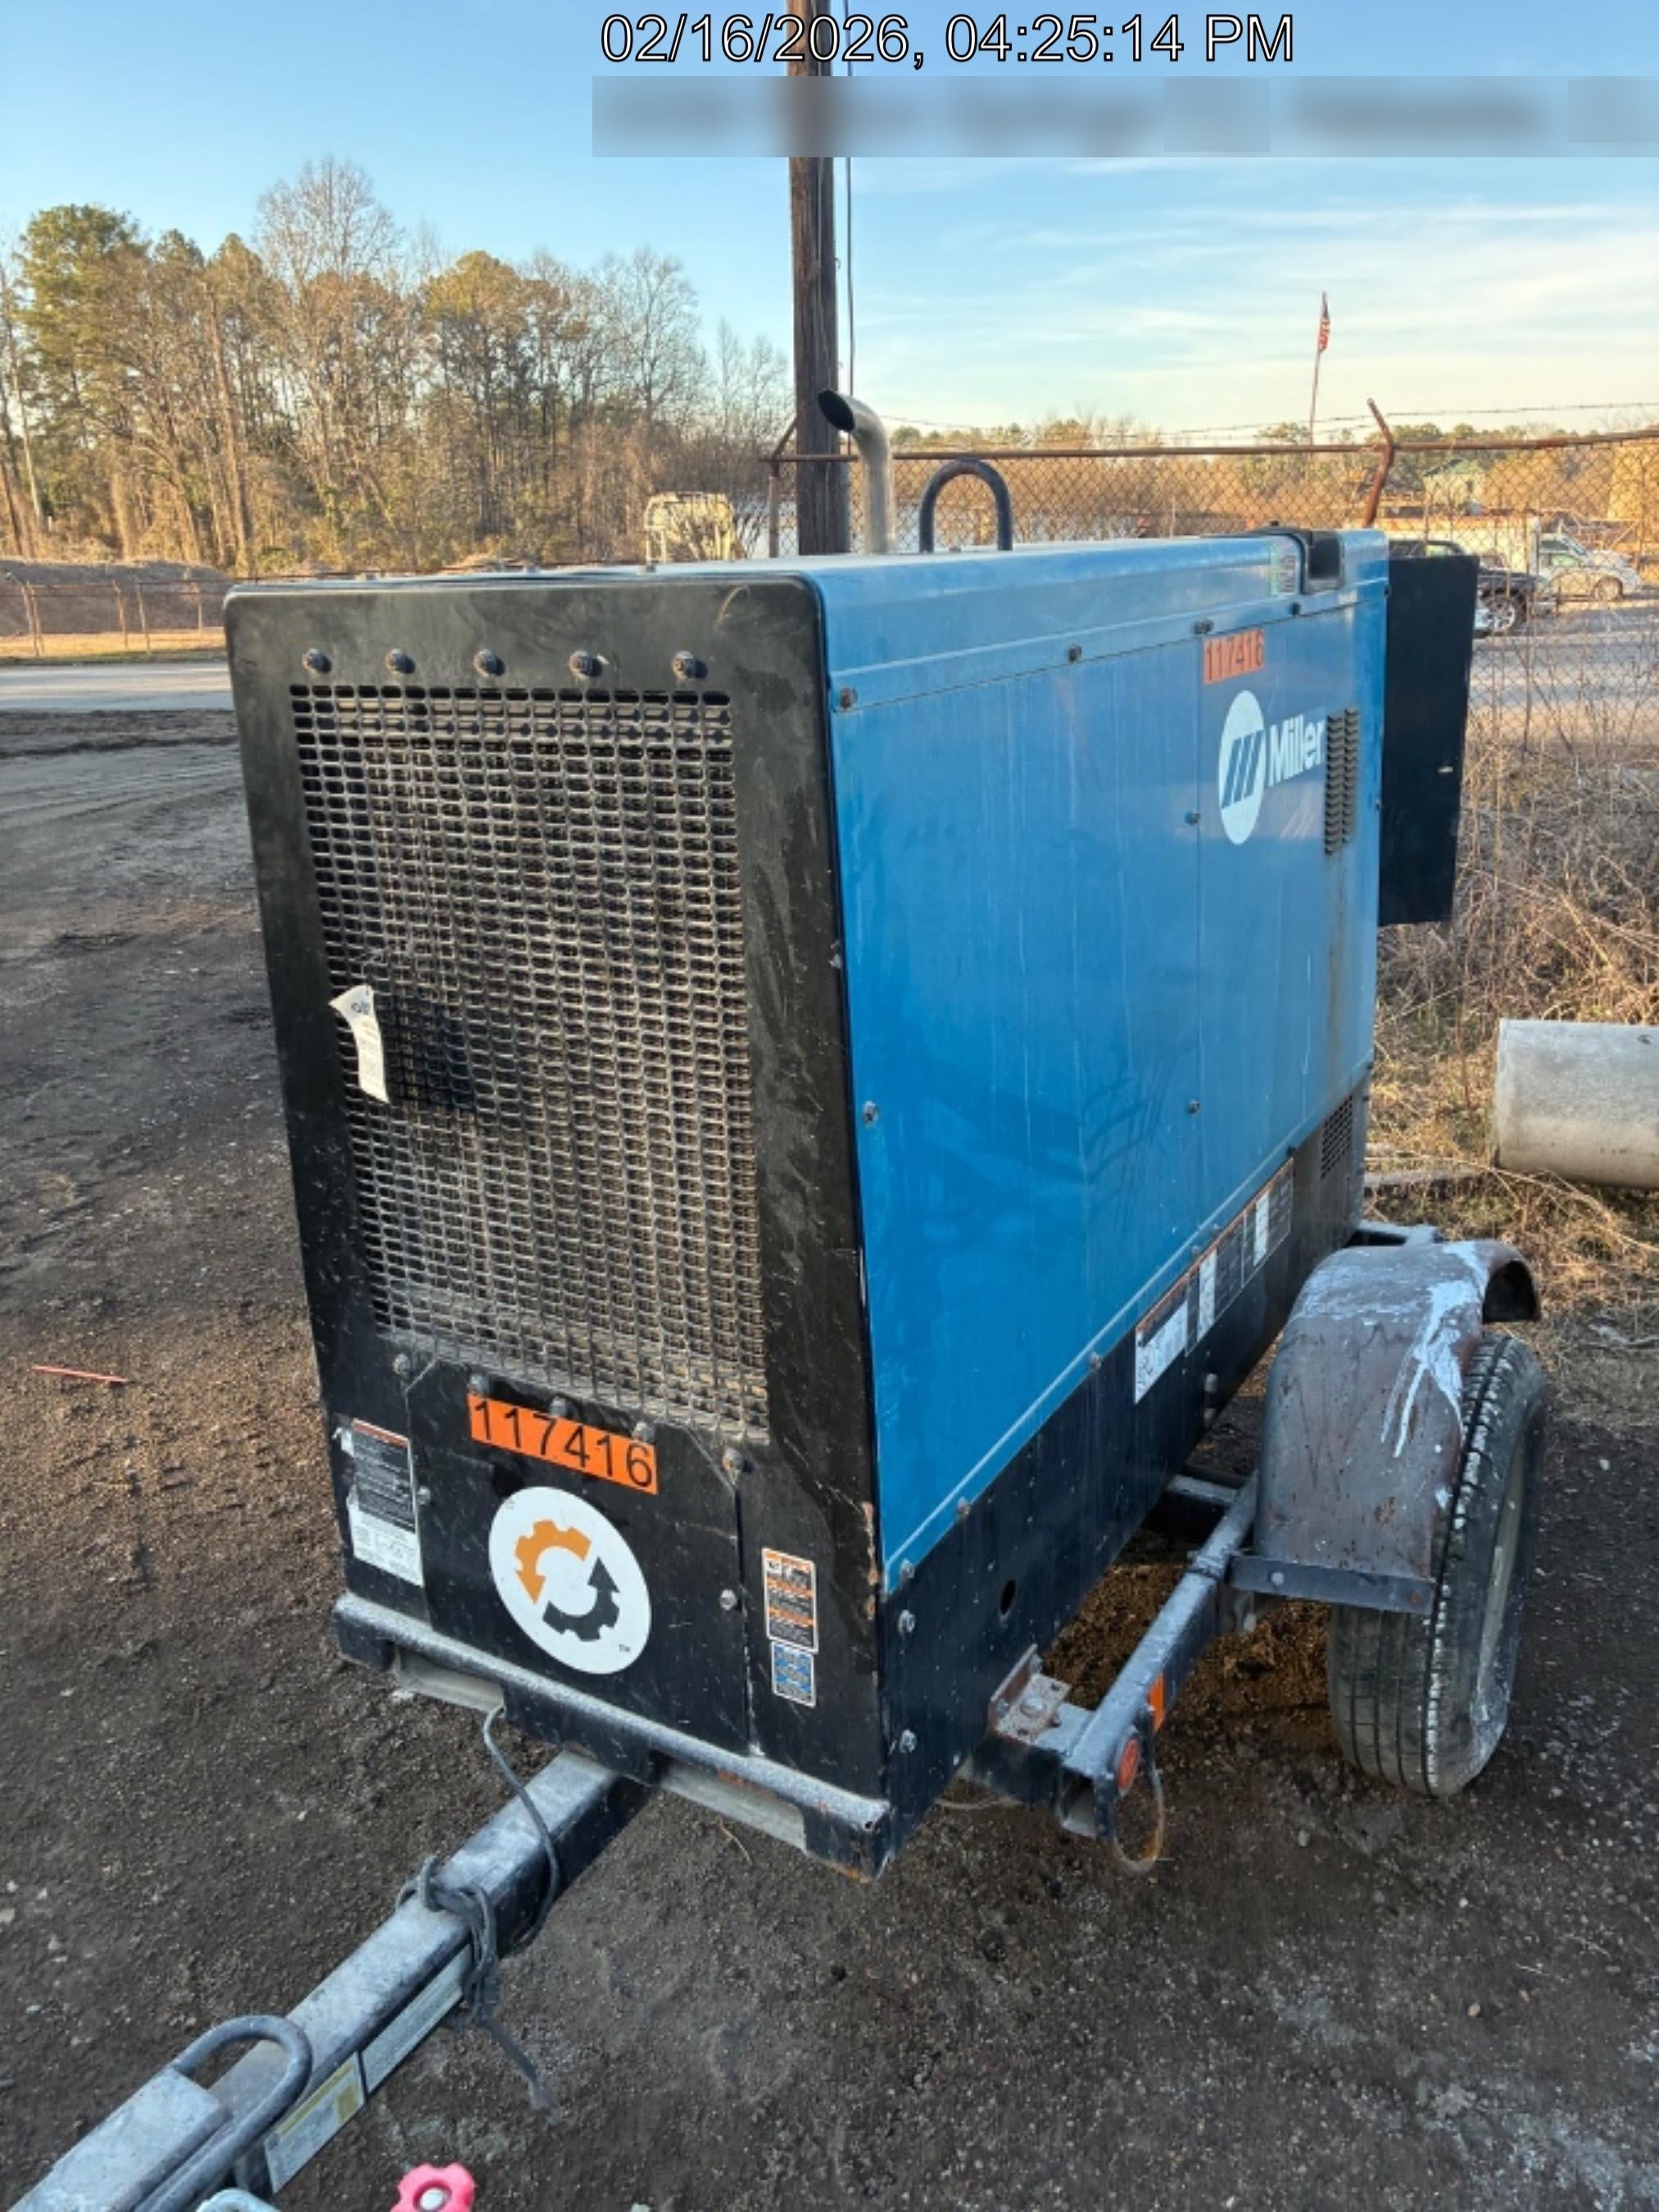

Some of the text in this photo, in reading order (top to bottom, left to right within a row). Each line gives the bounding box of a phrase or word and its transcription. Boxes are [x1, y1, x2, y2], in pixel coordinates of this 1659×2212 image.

[1206, 630, 1263, 682] 117416
[1268, 714, 1326, 787] Miller
[474, 1401, 653, 1487] 117416
